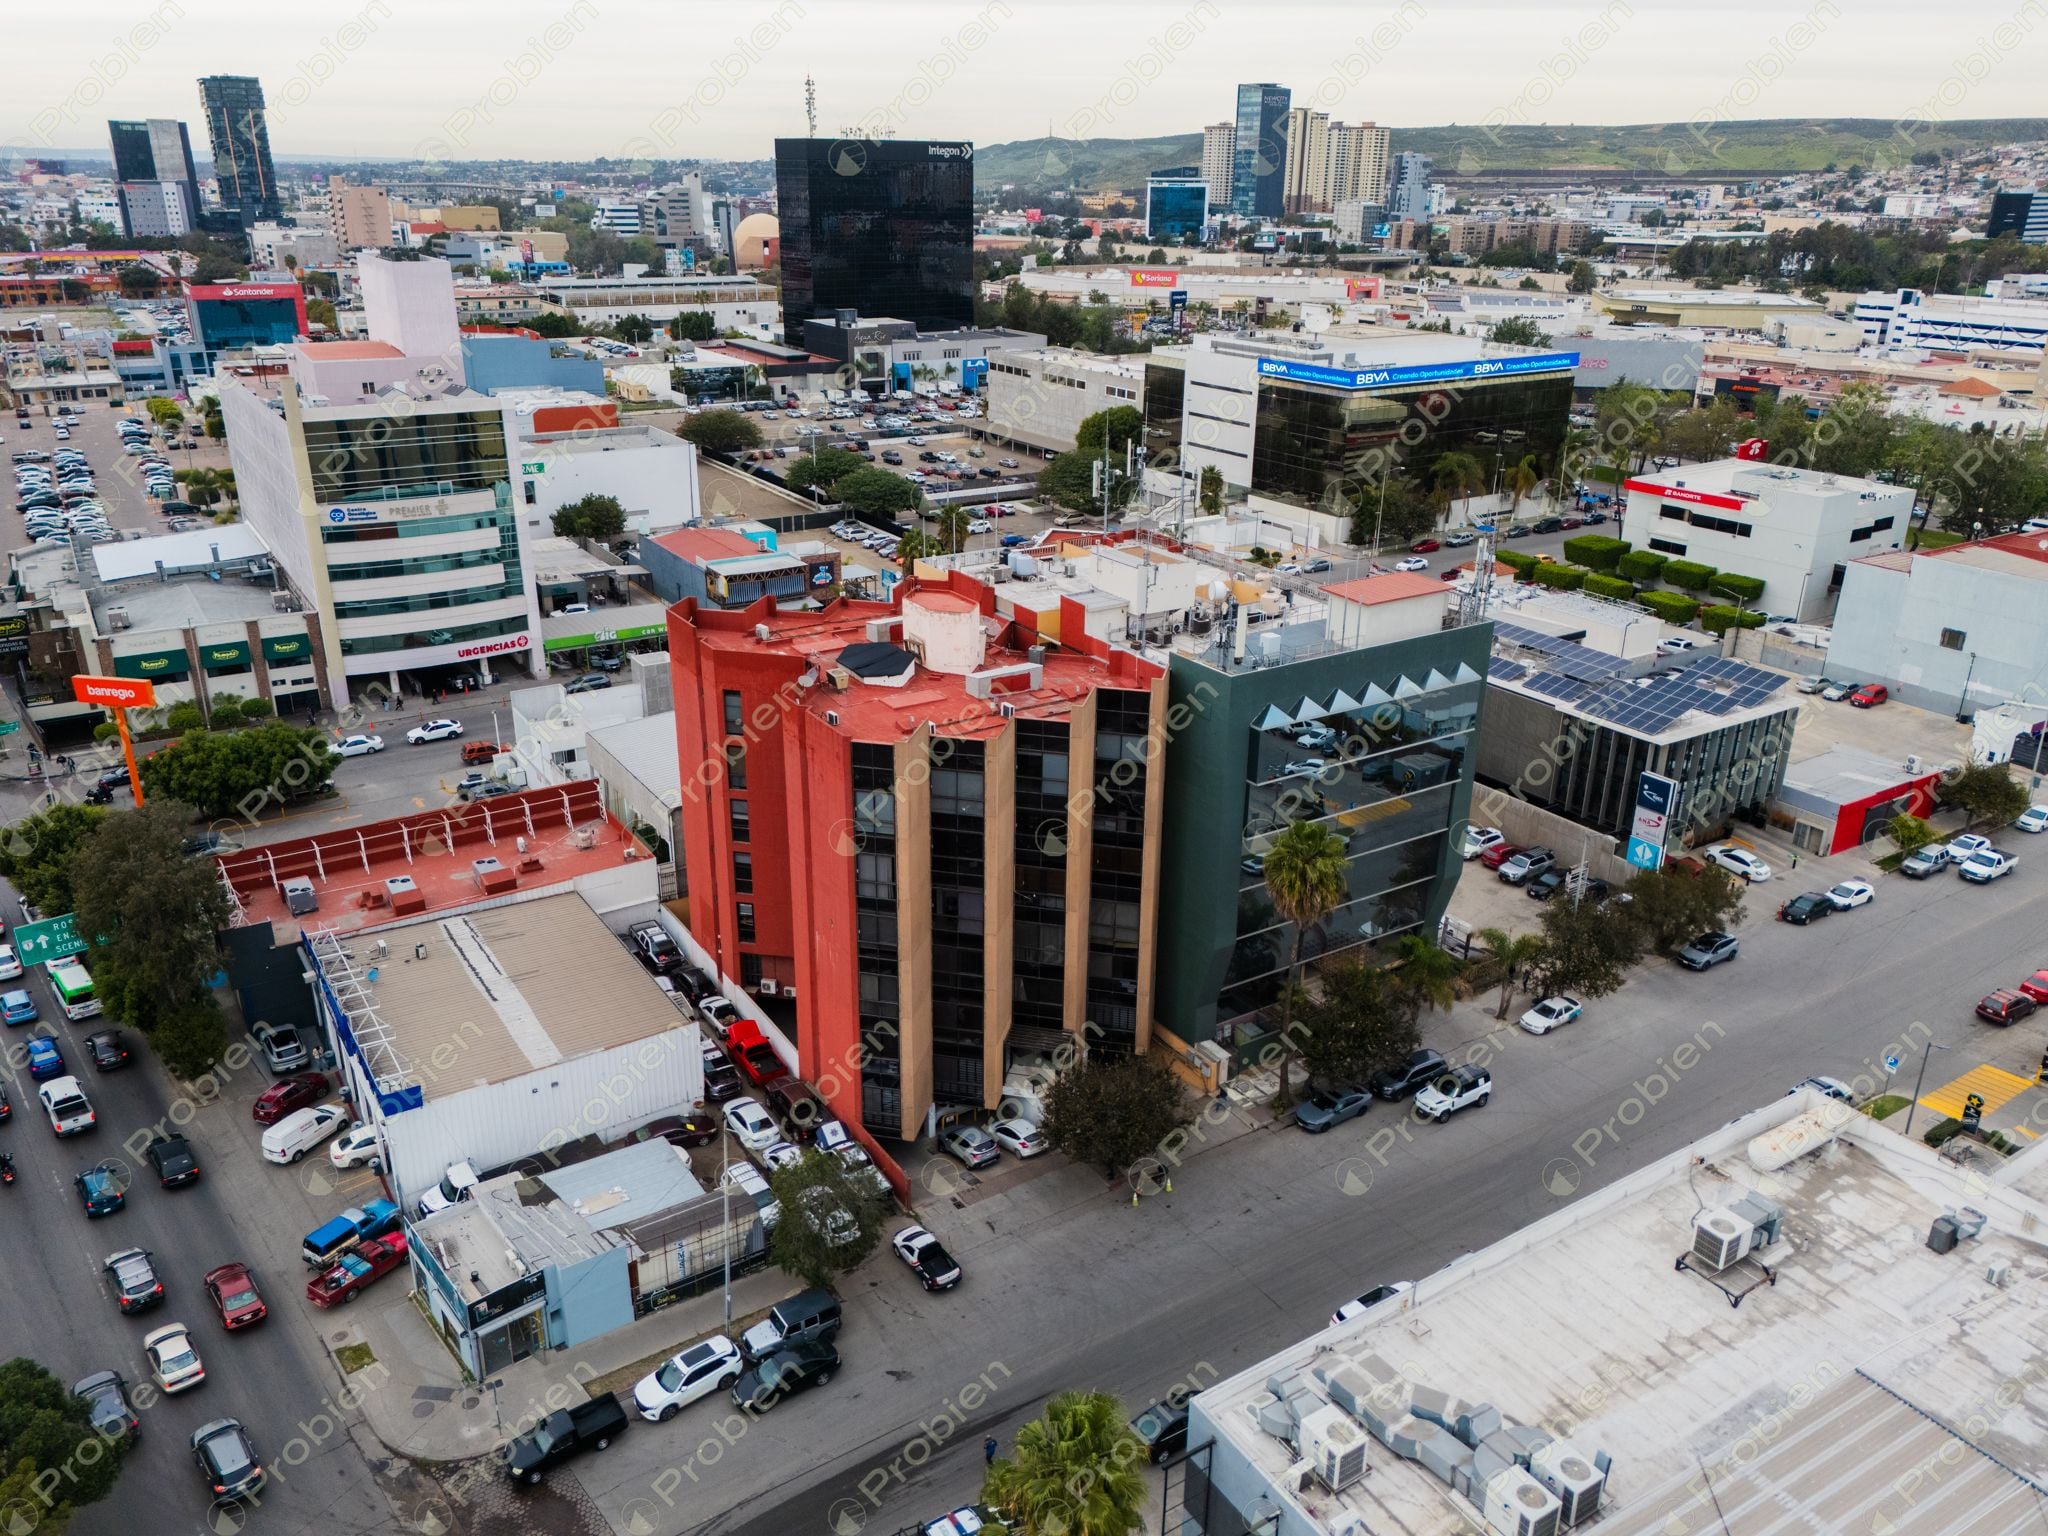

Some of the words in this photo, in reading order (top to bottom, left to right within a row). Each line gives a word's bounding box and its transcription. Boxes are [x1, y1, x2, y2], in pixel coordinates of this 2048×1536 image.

[928, 145, 960, 158] Integon
[233, 287, 274, 296] Santander
[1262, 362, 1288, 374] BBVA
[1474, 362, 1504, 374] BBVA
[1531, 358, 1571, 369] Oportunidades
[1356, 371, 1390, 385] BBVA
[1392, 372, 1418, 380] Creando
[1420, 368, 1464, 379] Oportunidades
[1672, 490, 1702, 501] BANORTE
[457, 639, 516, 658] URGENCIAS
[86, 684, 136, 700] banregio
